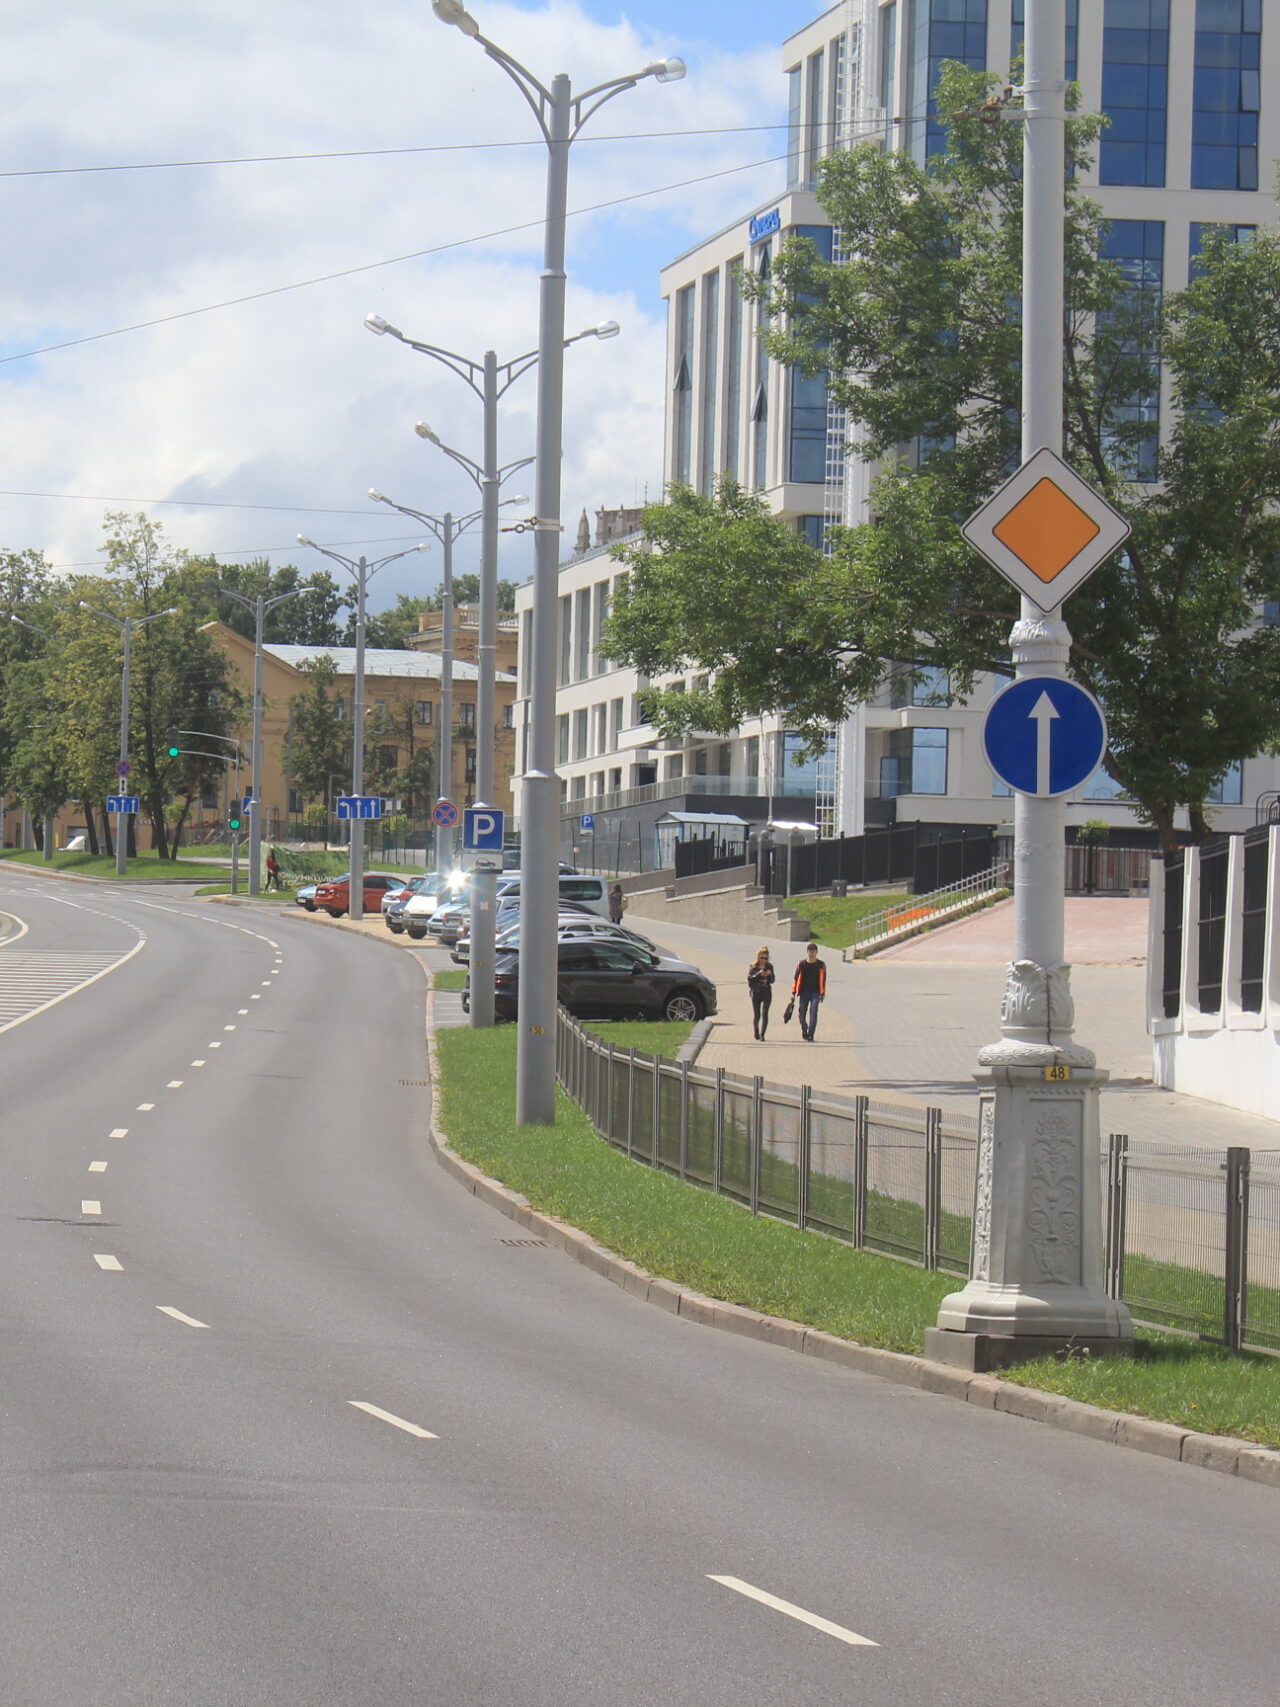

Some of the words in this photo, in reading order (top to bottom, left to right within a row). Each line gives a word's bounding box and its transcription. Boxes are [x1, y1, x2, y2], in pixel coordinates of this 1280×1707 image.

[583, 815, 592, 827] P
[472, 814, 495, 845] P
[1050, 1066, 1066, 1080] 48
